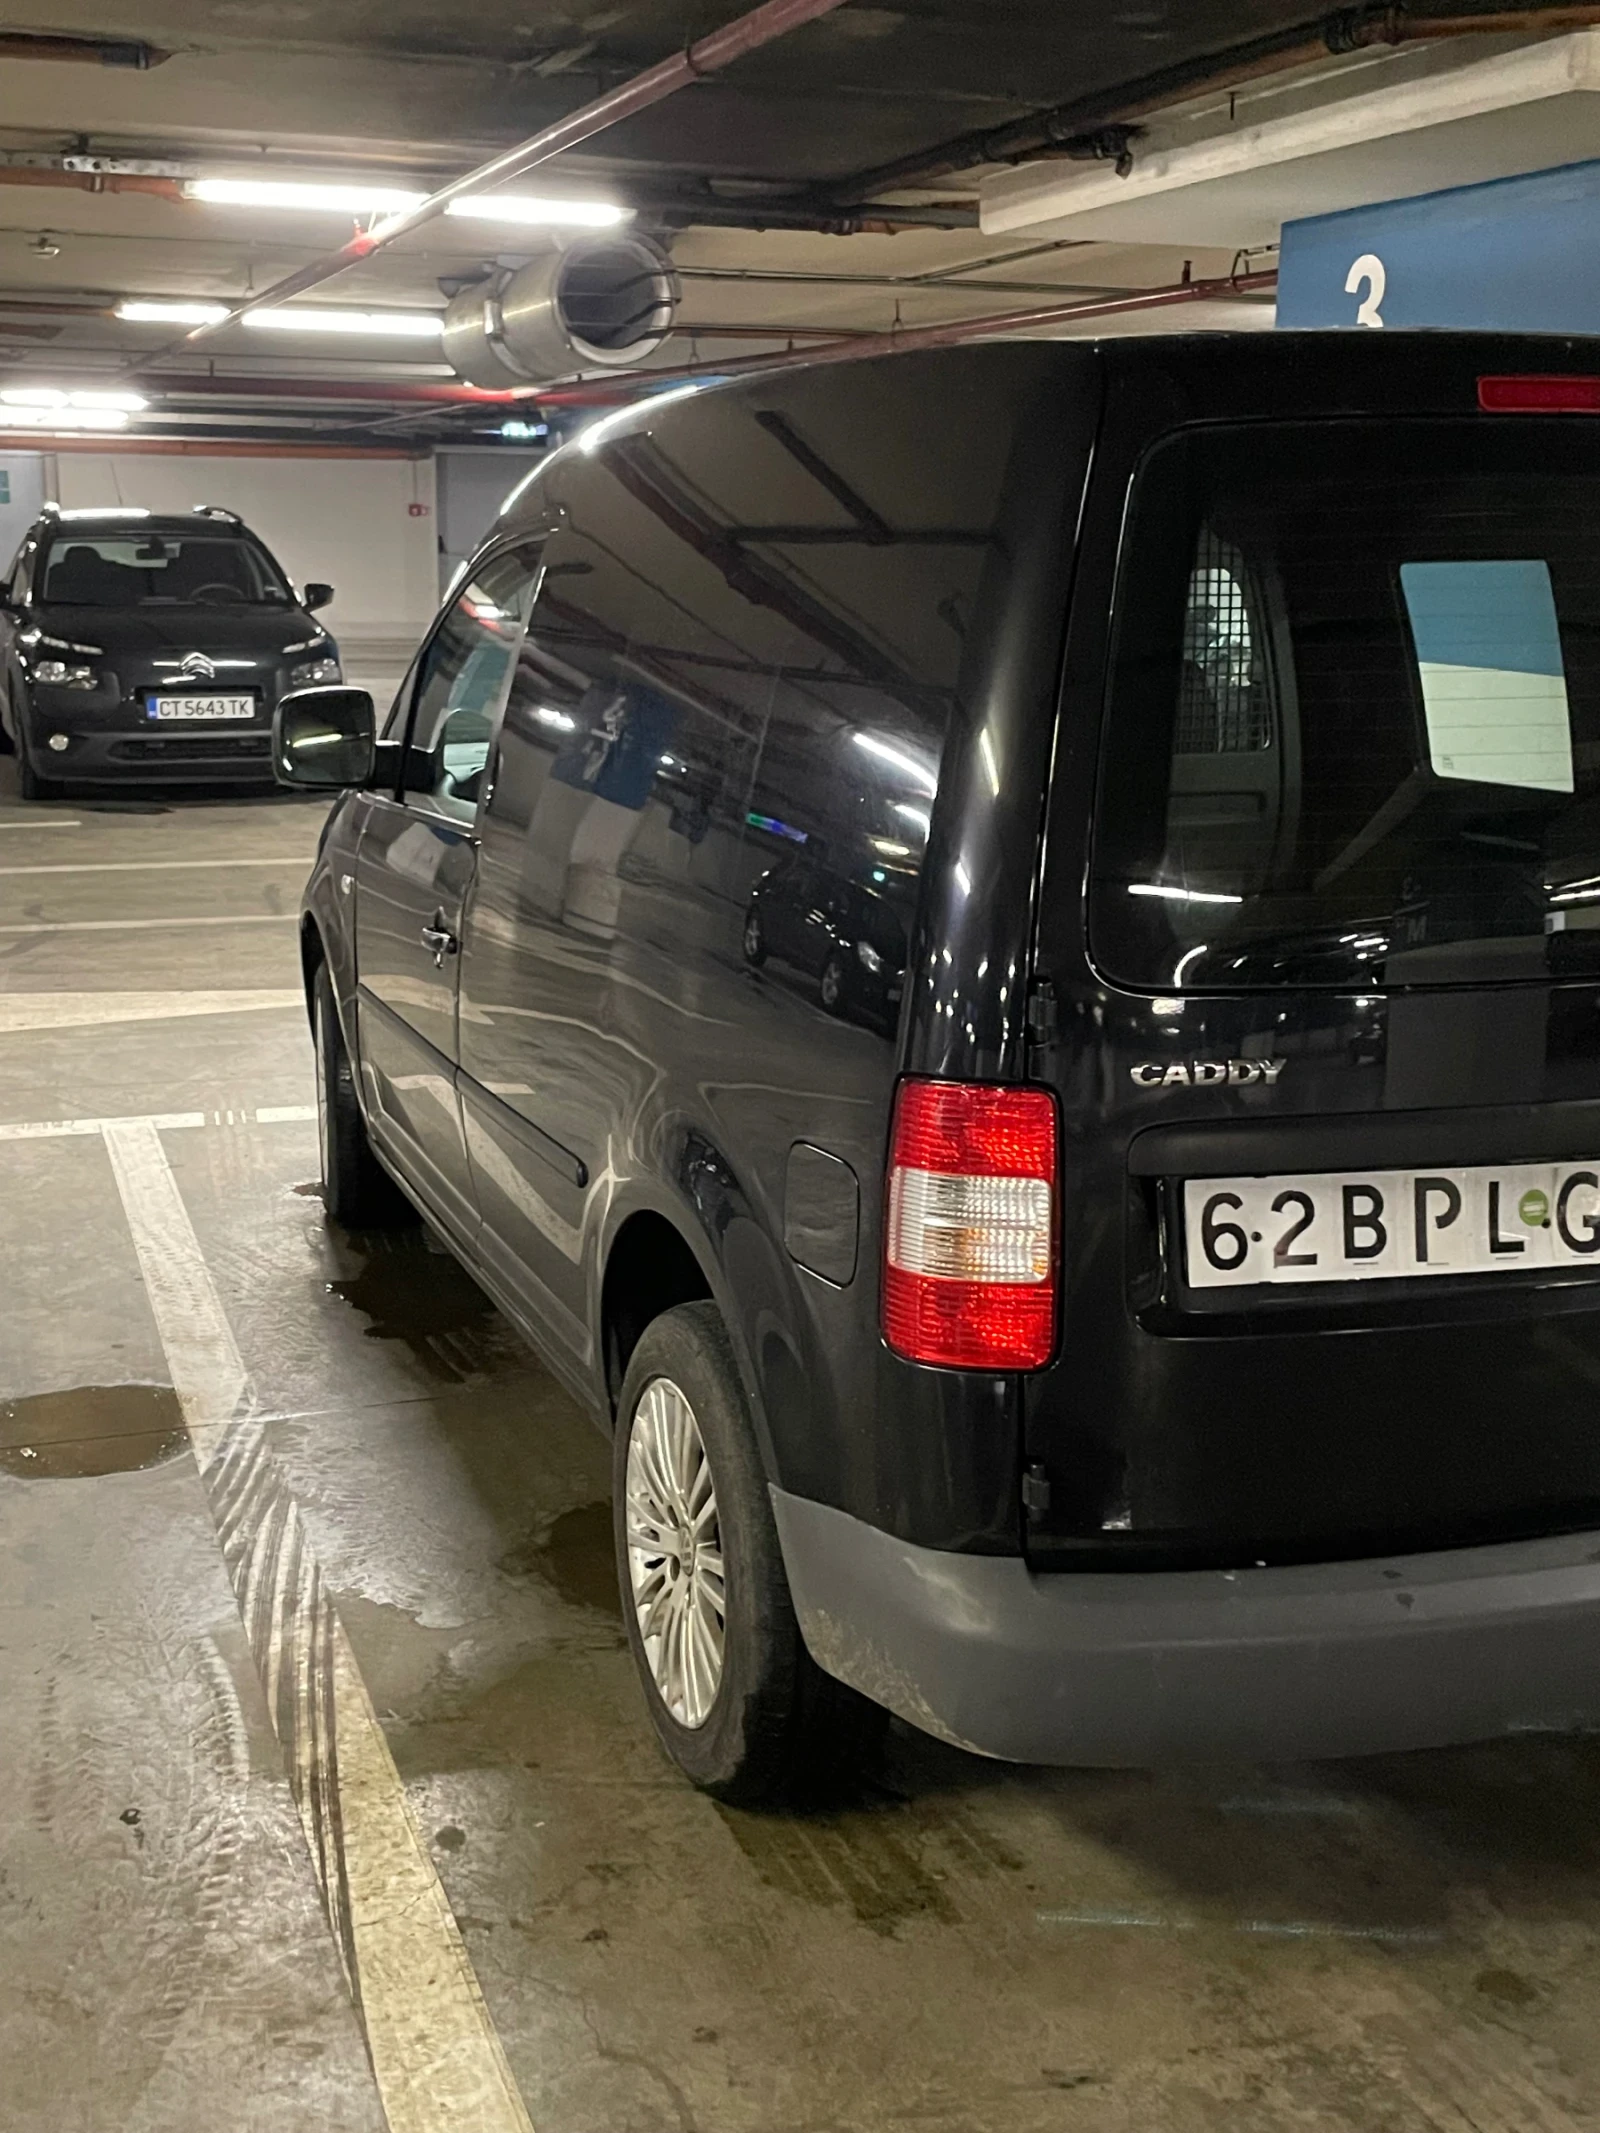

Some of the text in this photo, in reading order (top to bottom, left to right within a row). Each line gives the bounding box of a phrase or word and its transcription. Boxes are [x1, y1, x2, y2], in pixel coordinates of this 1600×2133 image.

[1345, 254, 1386, 328] 3
[160, 700, 181, 716] CT
[184, 700, 225, 716] 5643
[228, 700, 249, 715] TK
[1130, 1059, 1287, 1087] CADDY
